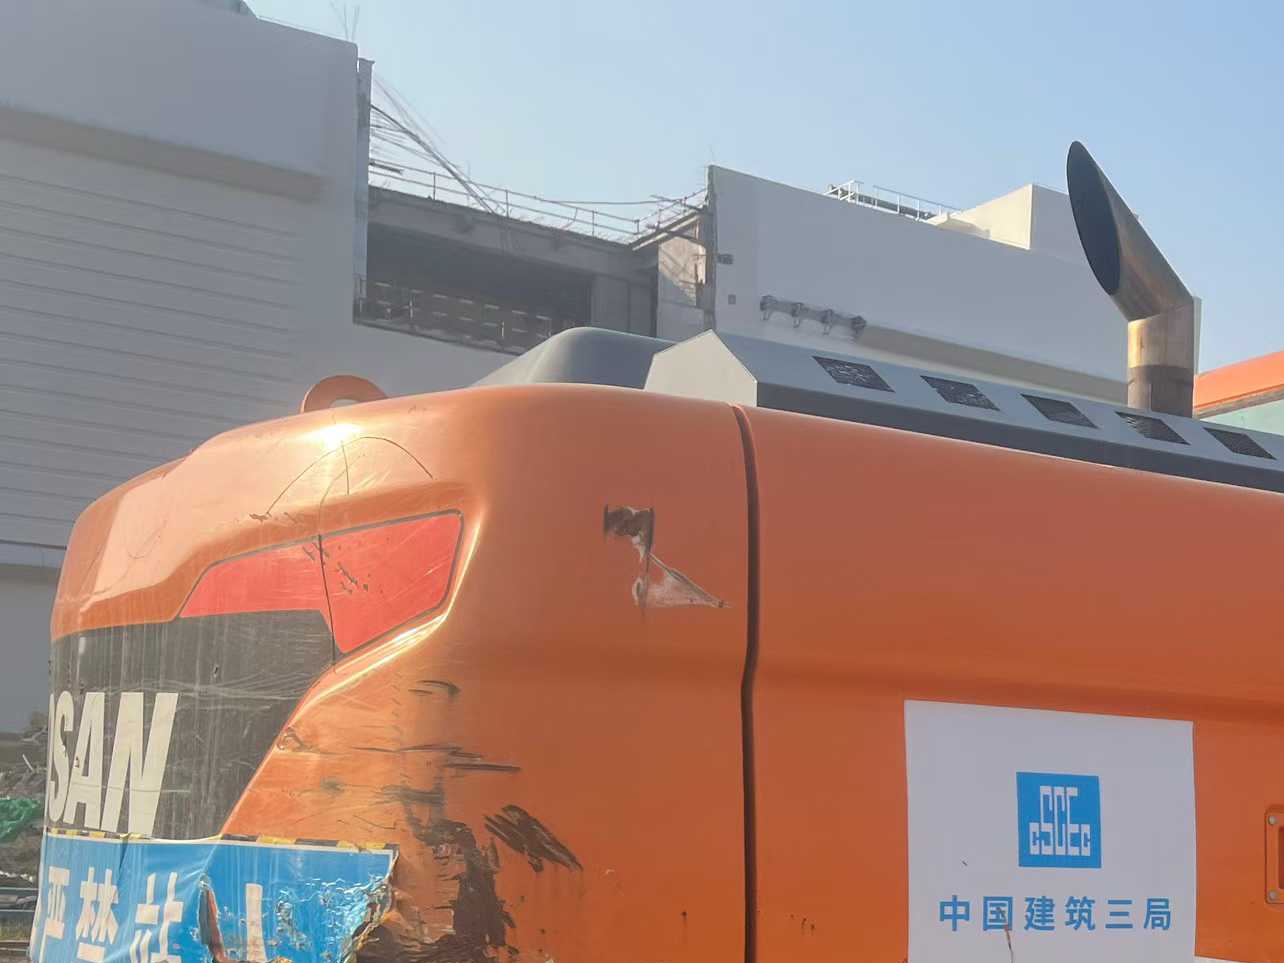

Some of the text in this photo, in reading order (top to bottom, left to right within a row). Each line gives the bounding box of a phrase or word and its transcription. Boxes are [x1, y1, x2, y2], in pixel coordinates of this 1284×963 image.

[49, 690, 179, 836] SAN
[939, 894, 1172, 932] 中国建筑三局
